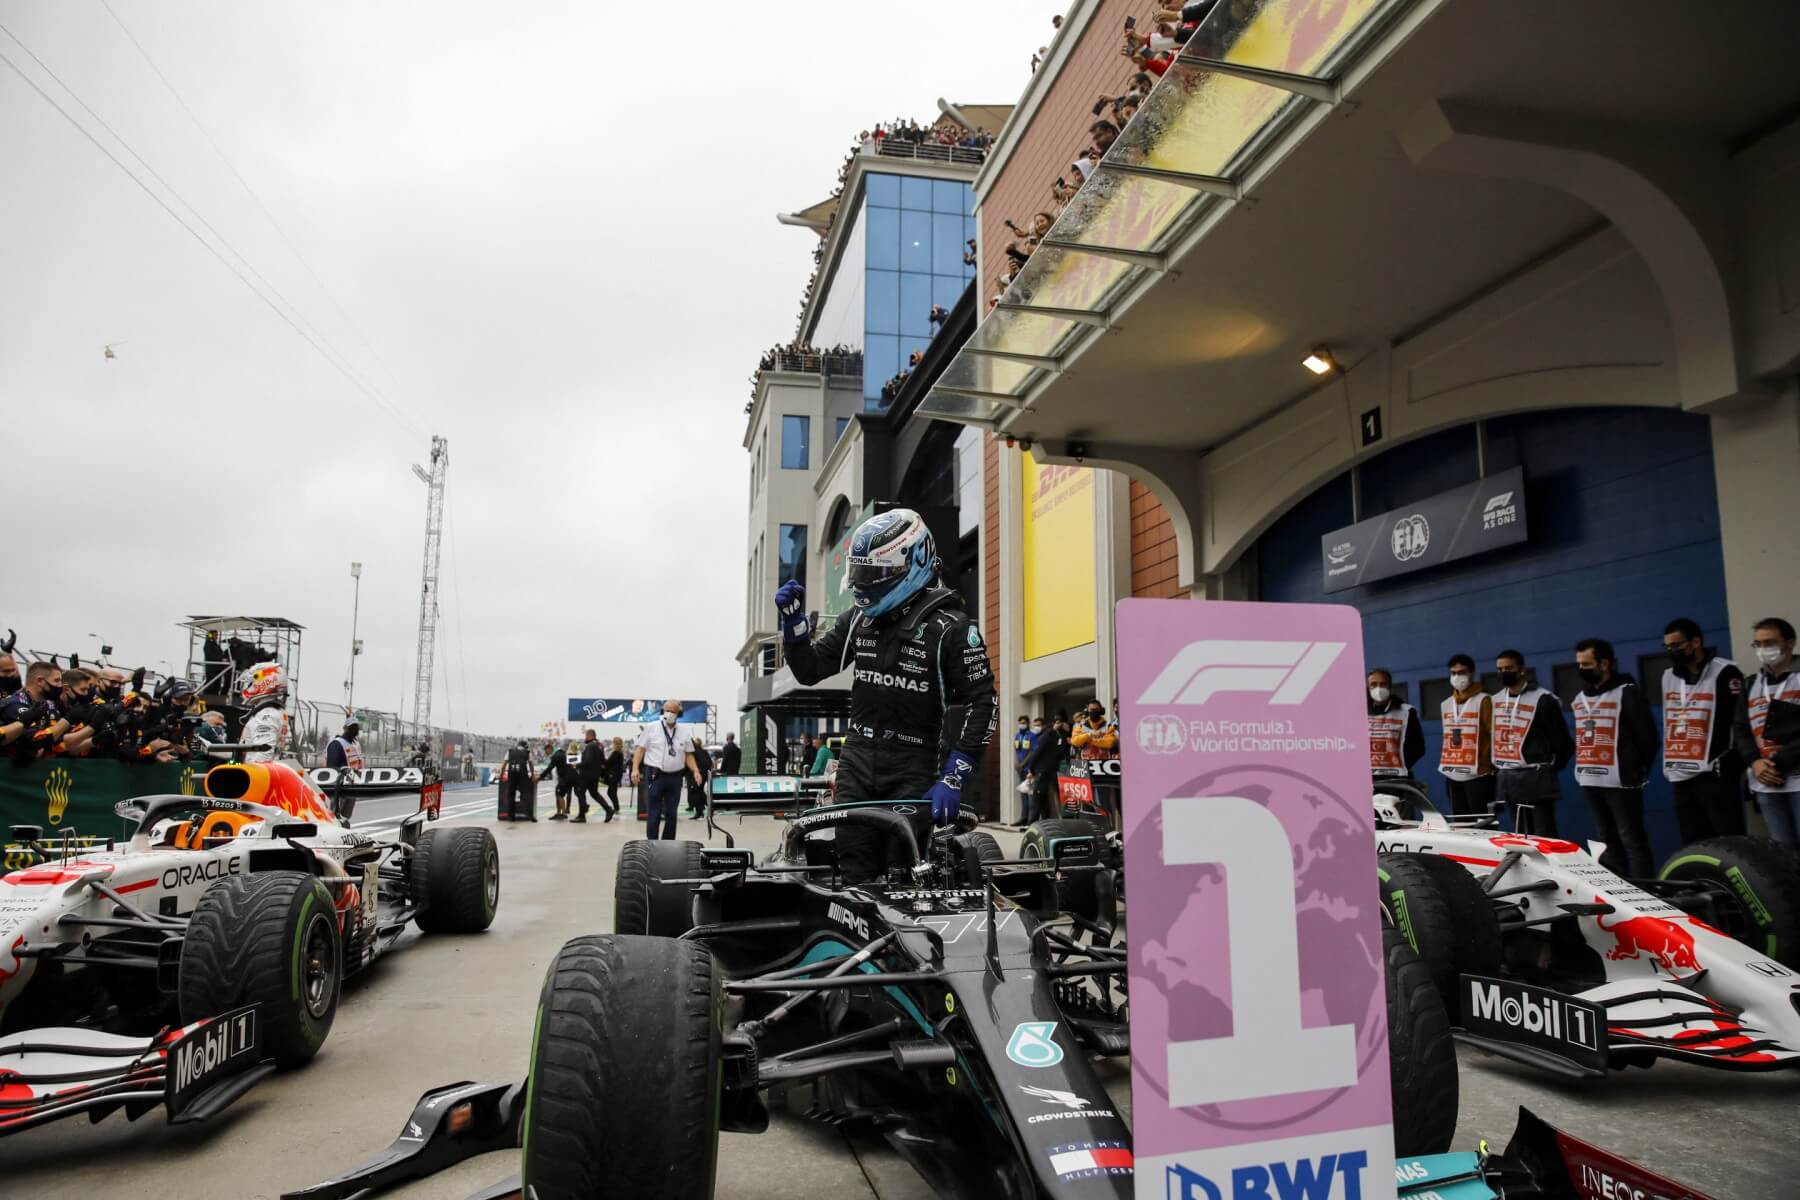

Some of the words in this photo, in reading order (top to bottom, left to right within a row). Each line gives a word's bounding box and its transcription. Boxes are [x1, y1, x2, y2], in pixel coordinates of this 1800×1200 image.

[1366, 415, 1375, 437] 1
[1484, 519, 1496, 530] AS
[1497, 513, 1516, 526] ONE
[862, 639, 877, 648] UBS
[855, 668, 930, 693] PETRONAS
[1190, 720, 1216, 735] FIA
[1219, 719, 1284, 735] Formula
[1286, 720, 1296, 735] 1
[1189, 738, 1239, 753] World
[303, 767, 424, 785] ONDA
[211, 800, 235, 809] Tezos
[800, 809, 849, 827] CROWDSTRIKE
[162, 855, 241, 890] ORACLE
[841, 907, 870, 941] AMG
[1161, 796, 1359, 1109] 1
[1471, 981, 1561, 1040] Mobil
[175, 1020, 229, 1094] Mobil
[1027, 1110, 1115, 1124] CROWDSTRIKE
[1053, 1142, 1120, 1153] TOMMY
[1231, 1150, 1368, 1200] BWT
[1582, 1164, 1646, 1200] INEOS
